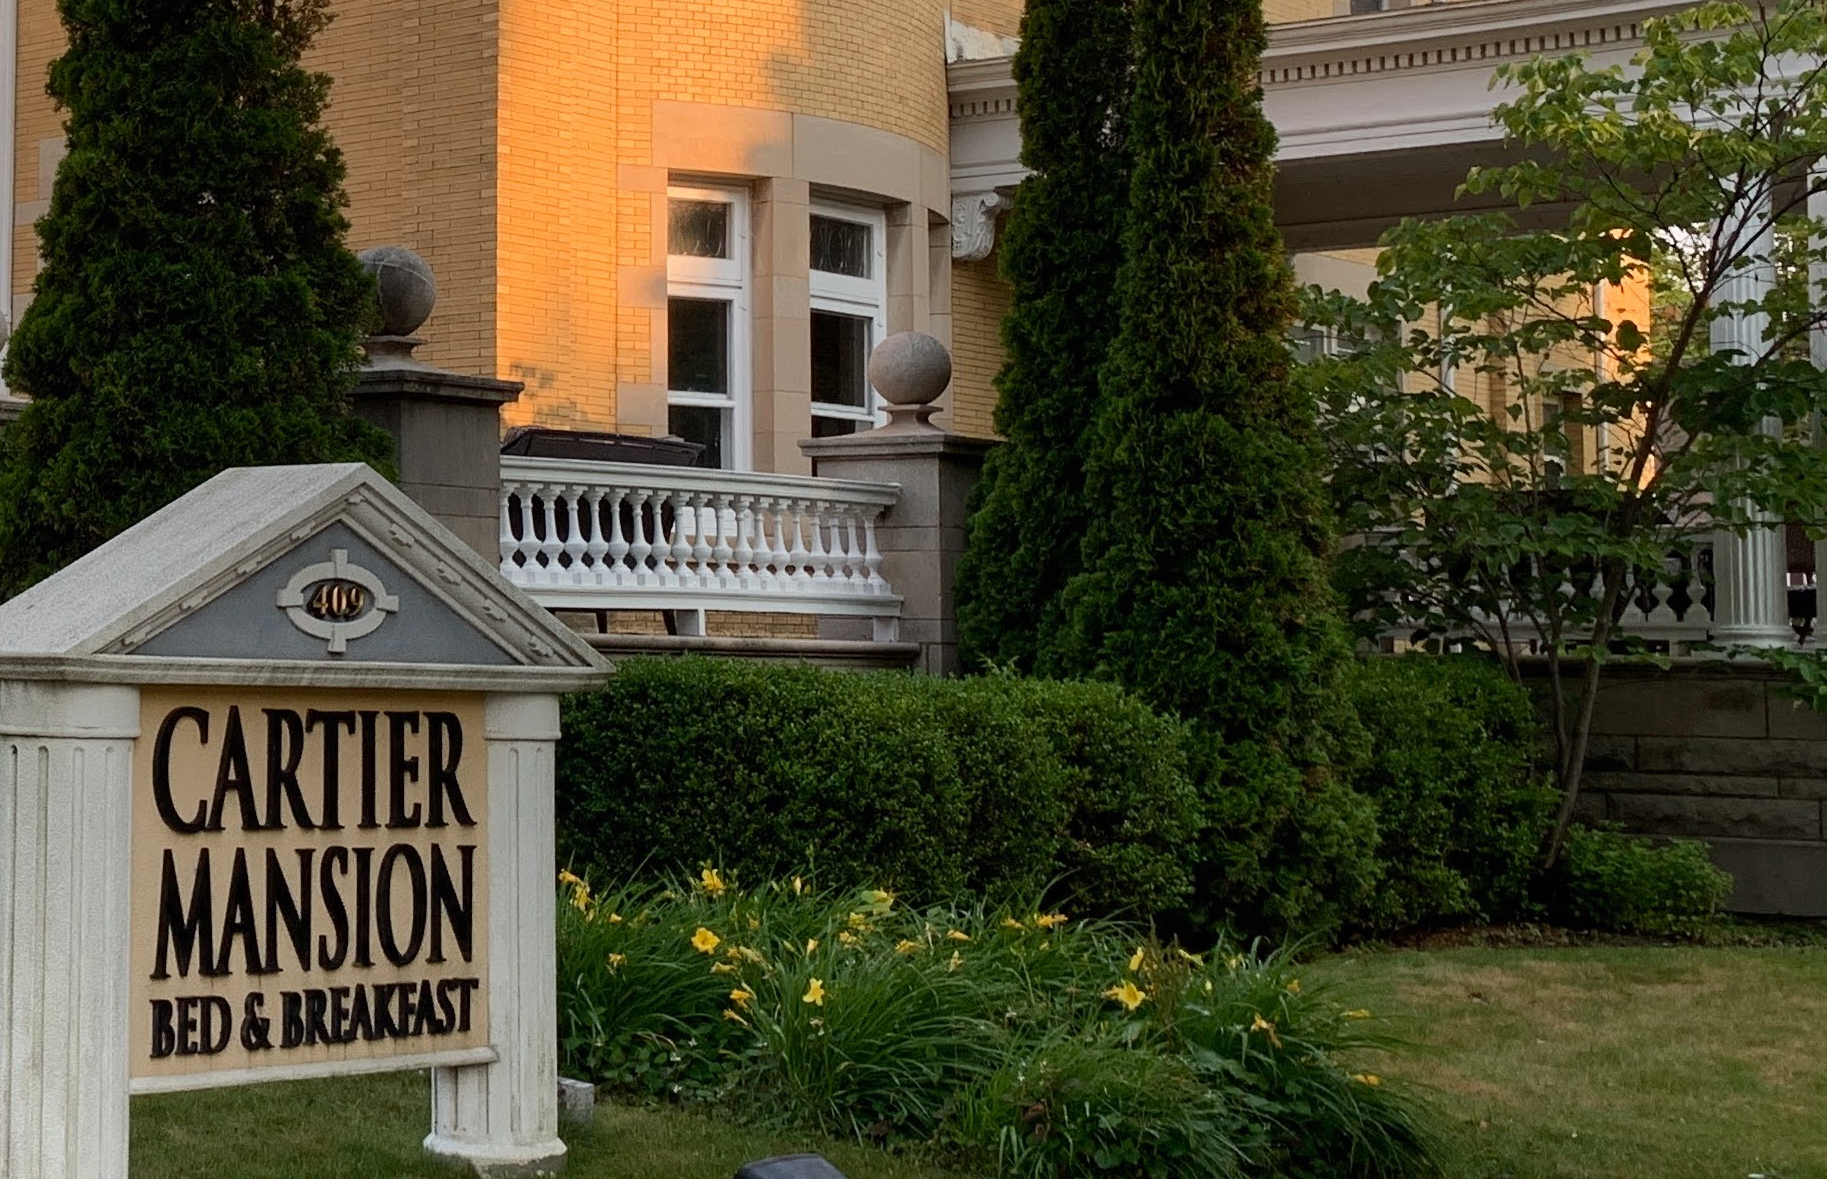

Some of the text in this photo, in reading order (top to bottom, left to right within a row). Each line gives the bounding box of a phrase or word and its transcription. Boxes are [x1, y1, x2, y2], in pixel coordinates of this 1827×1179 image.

[311, 584, 365, 617] 409
[152, 705, 478, 834] CARTIER
[149, 843, 477, 979] MANSION
[149, 978, 479, 1058] BED & BREAKFAST
